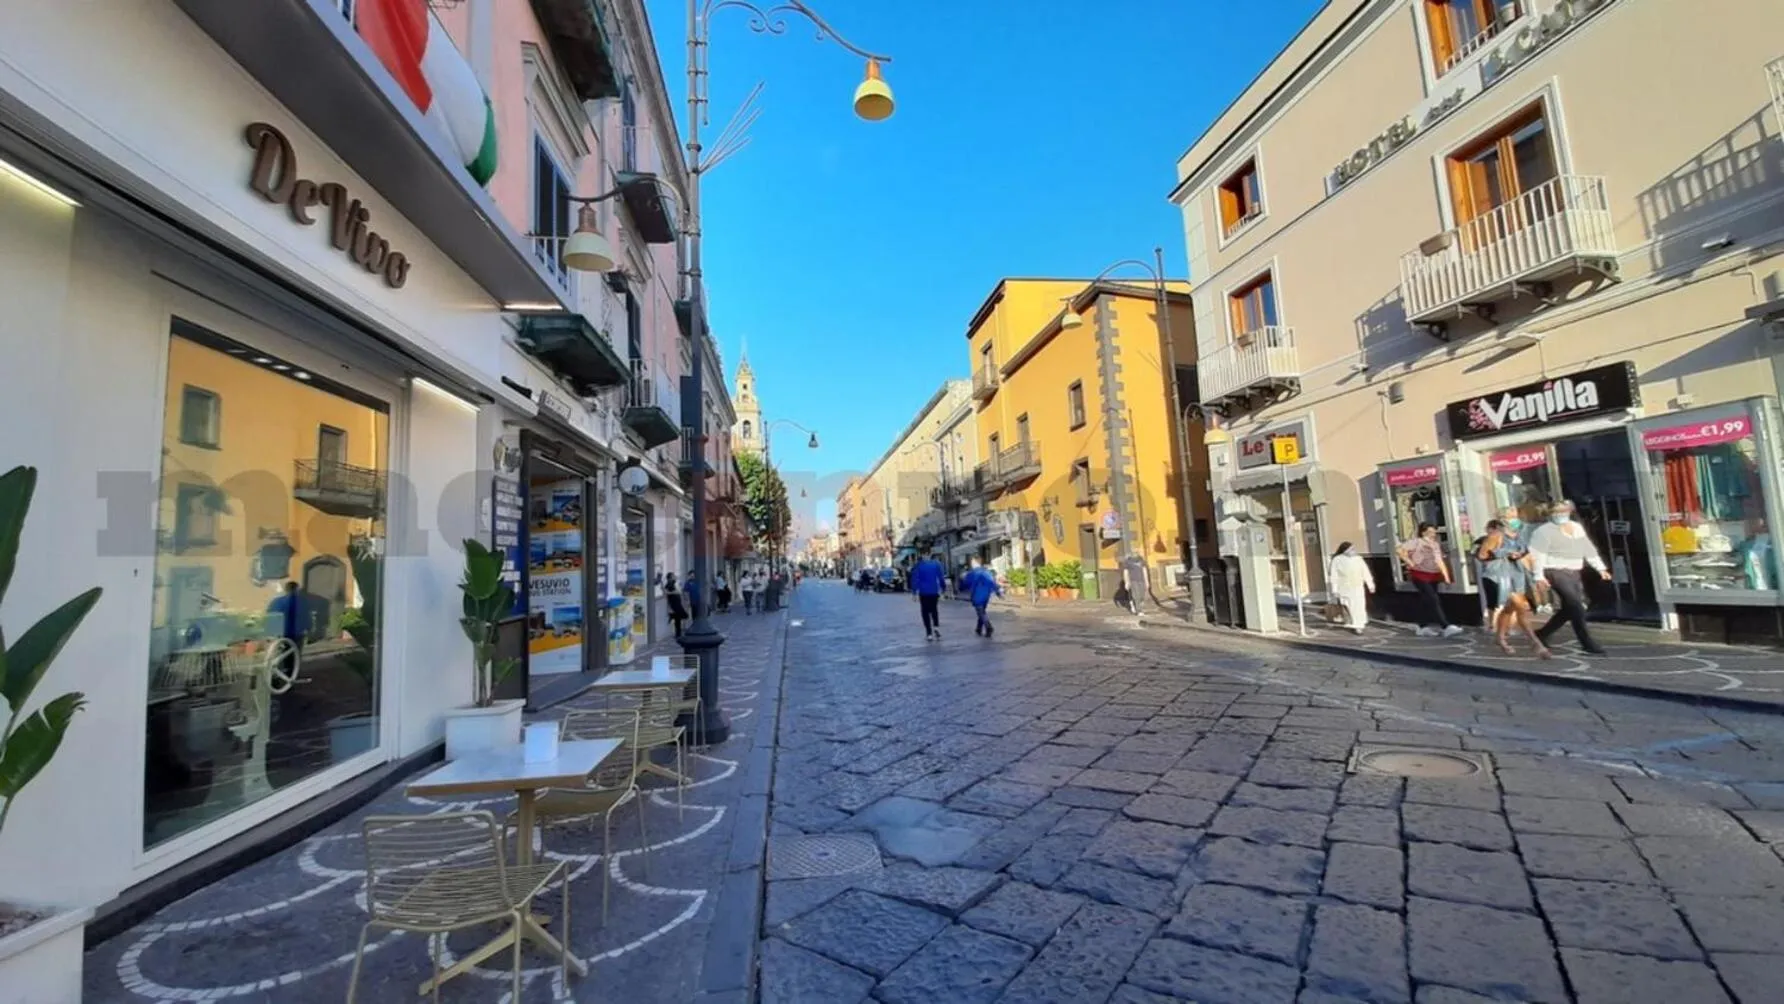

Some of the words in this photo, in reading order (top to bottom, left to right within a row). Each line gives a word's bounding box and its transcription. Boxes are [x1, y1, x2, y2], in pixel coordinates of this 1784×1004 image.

[1335, 115, 1416, 184] HOTEL
[1479, 378, 1600, 430] Vanilla
[1242, 439, 1264, 456] Le
[1284, 443, 1294, 457] P
[528, 577, 570, 589] VESUVIO
